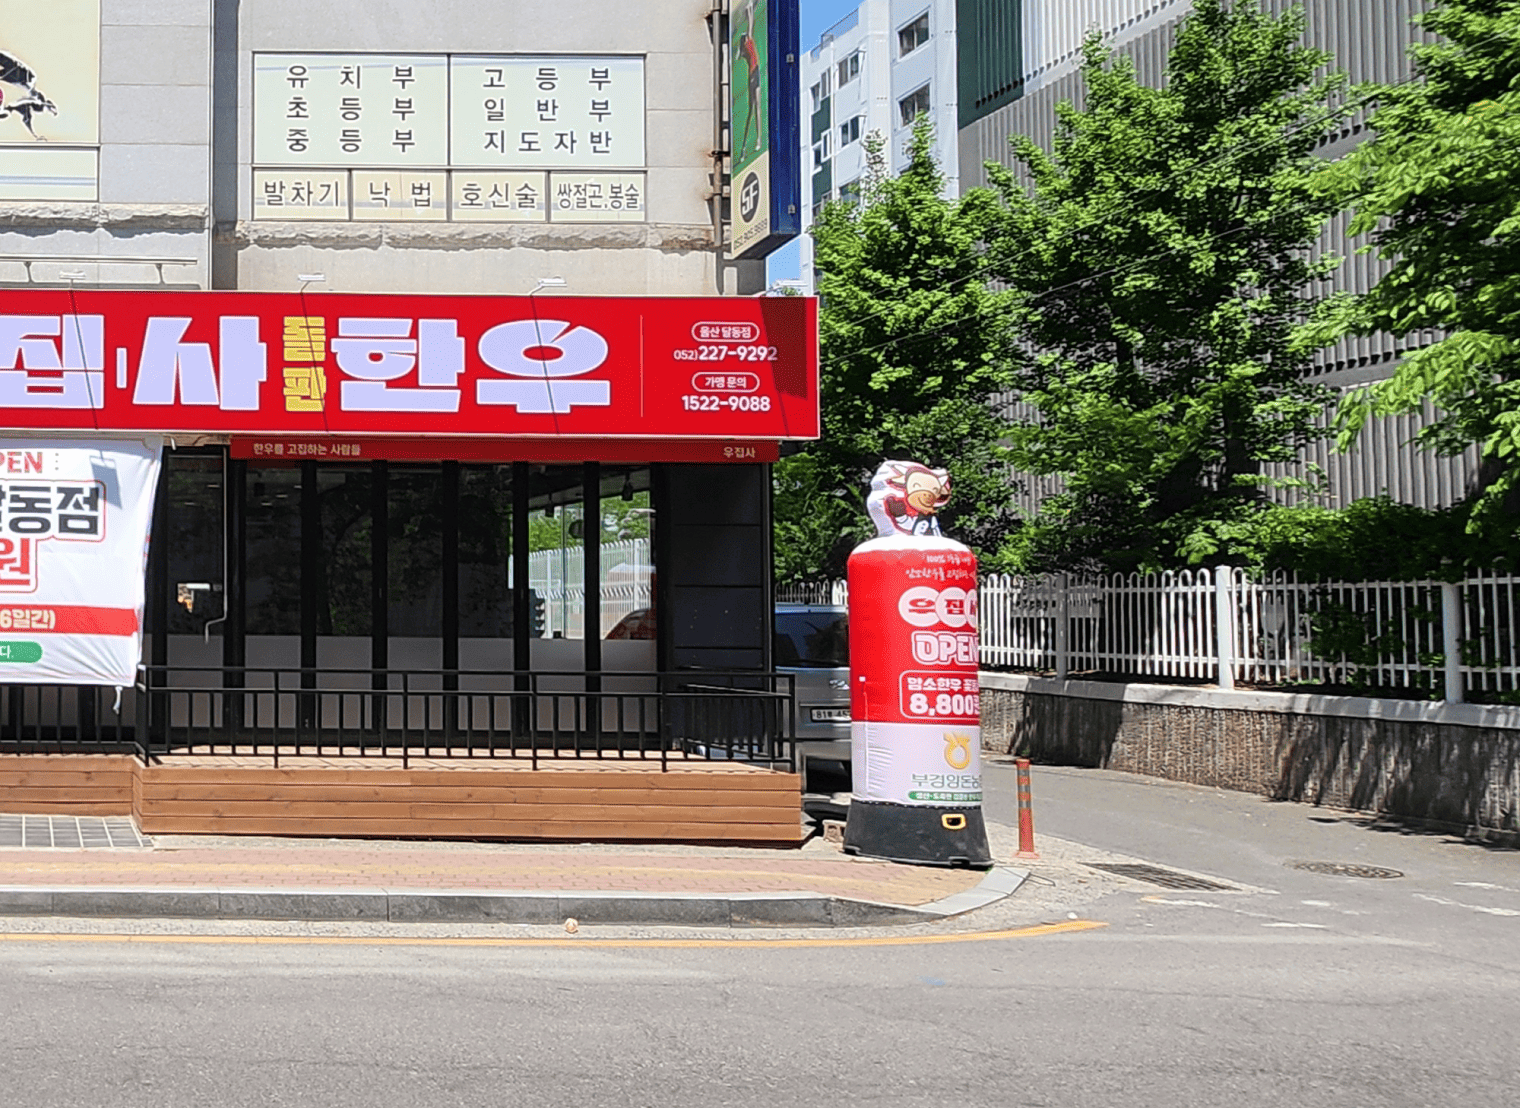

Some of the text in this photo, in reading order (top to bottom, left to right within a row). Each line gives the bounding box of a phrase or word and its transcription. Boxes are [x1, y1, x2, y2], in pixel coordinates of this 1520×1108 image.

[483, 130, 613, 154] 지도자반
[264, 180, 340, 207] 발차기
[460, 182, 539, 208] 호신술
[741, 179, 758, 216] SF
[699, 325, 752, 339] 울산 달동점
[330, 317, 611, 414] 한우
[704, 376, 747, 389] 가맹 문의
[681, 395, 771, 412] 1522-9088
[253, 443, 361, 456] 한우를 고집하는 사람들
[723, 446, 756, 459] 우집사
[907, 677, 962, 692] 암소한우
